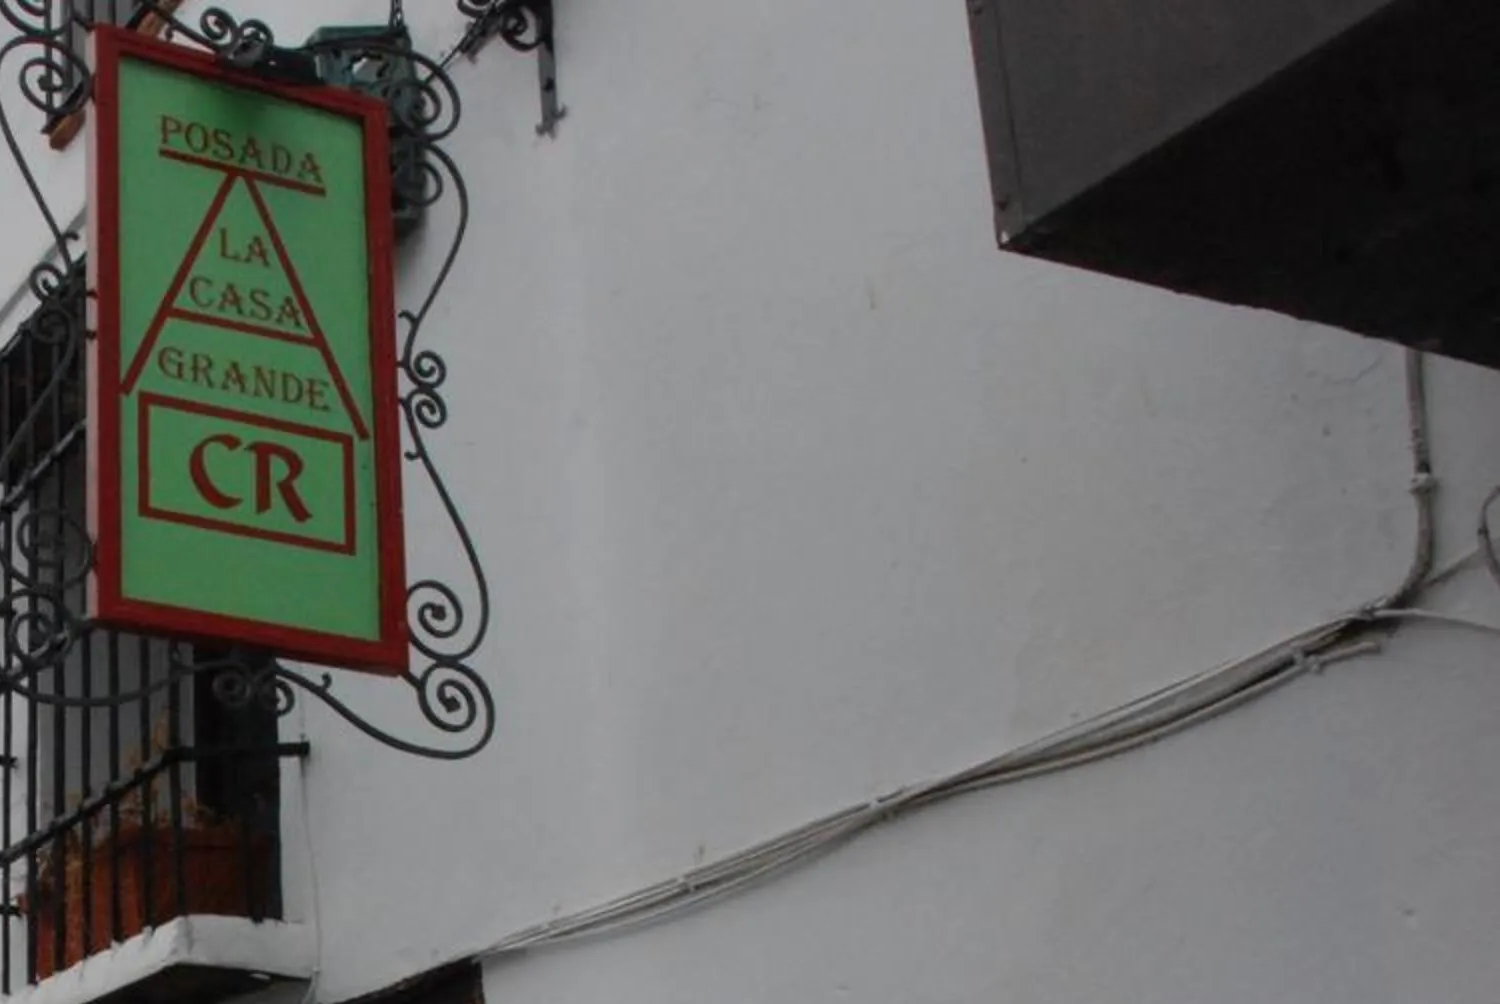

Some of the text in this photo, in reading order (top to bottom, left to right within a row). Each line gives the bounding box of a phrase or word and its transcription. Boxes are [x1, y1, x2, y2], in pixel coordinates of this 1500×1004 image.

[158, 114, 324, 185] POSADA
[219, 227, 270, 268] LA
[189, 276, 303, 328] CASA
[157, 345, 331, 412] GRANDE
[189, 433, 313, 524] CR
